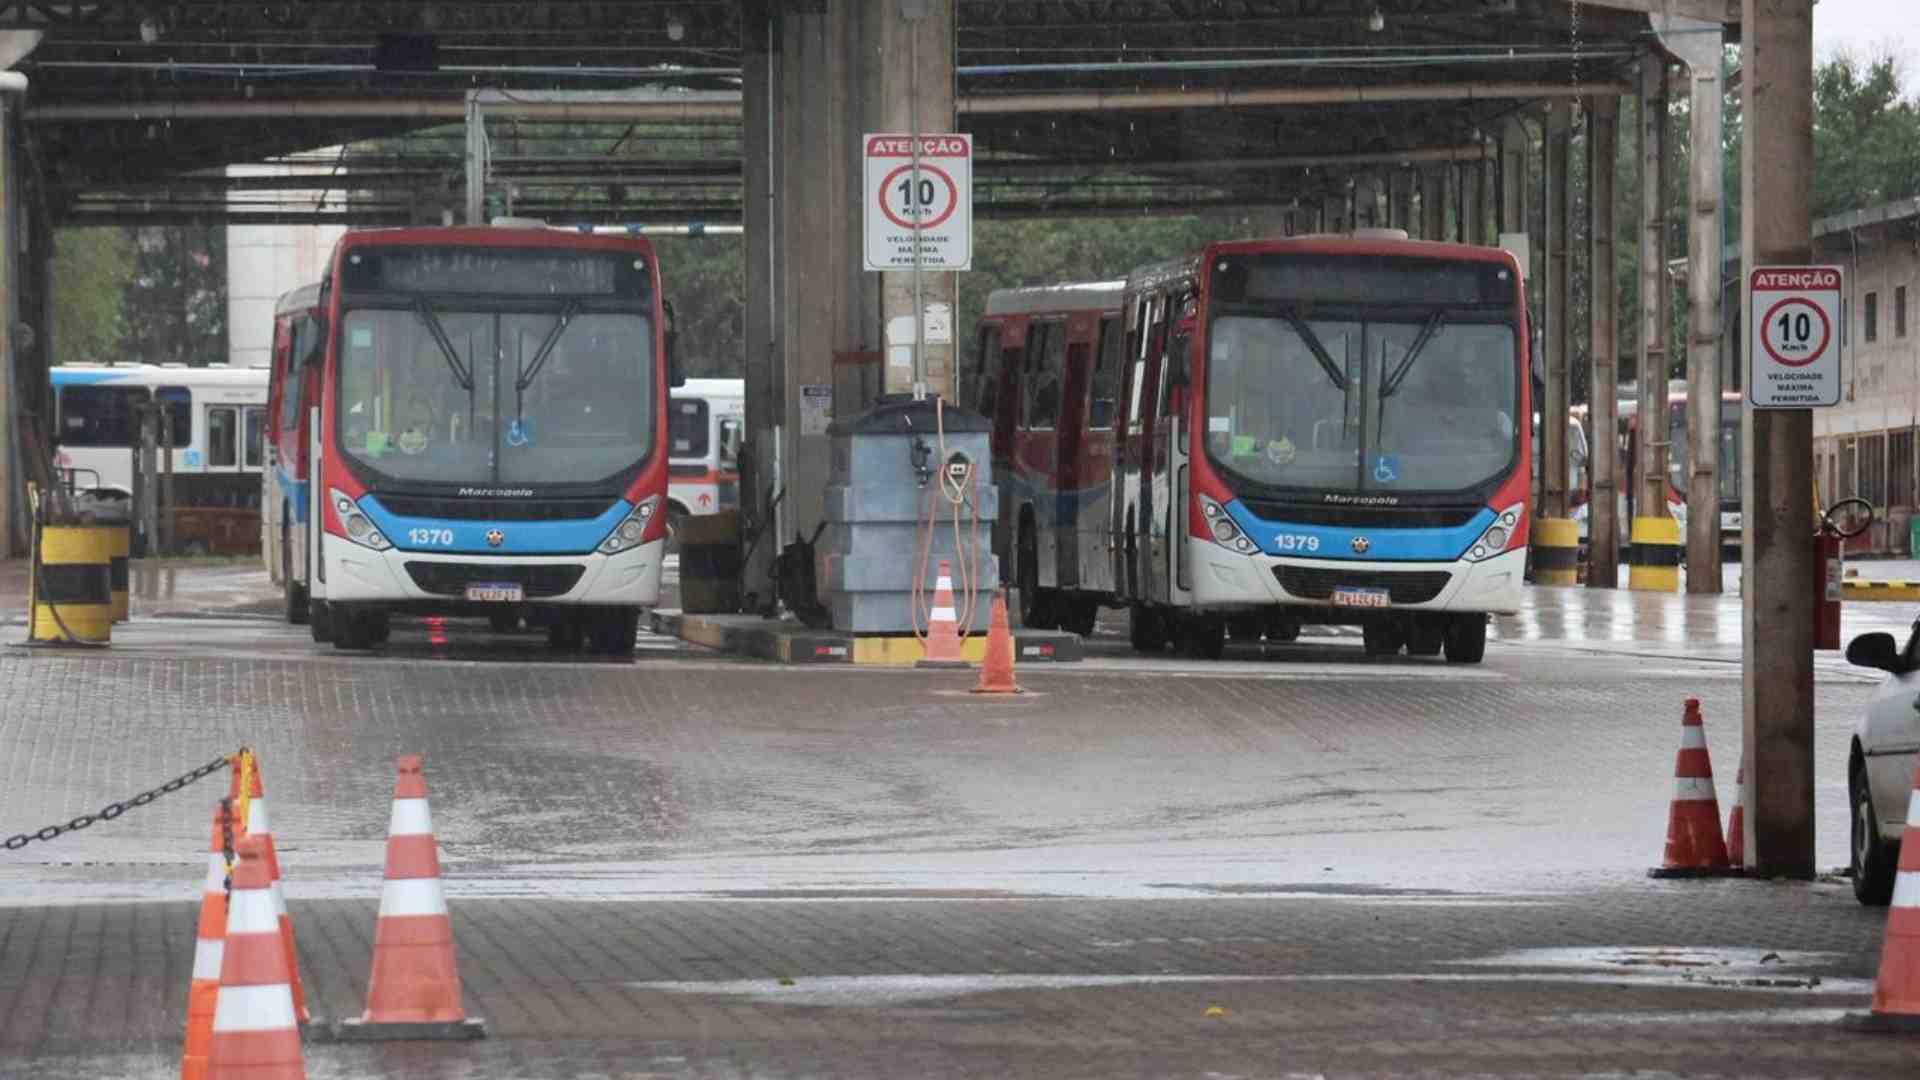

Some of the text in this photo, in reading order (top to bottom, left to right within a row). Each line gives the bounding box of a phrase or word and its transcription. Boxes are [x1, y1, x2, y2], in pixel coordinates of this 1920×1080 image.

[898, 178, 935, 206] 10
[902, 207, 932, 216] Kh
[1756, 272, 1836, 289] ATENÇÃO
[1778, 312, 1811, 342] 10
[1767, 372, 1825, 381] VELOCIDADE
[1770, 394, 1821, 402] PERMITIDA
[1323, 493, 1399, 505] Marcopolo
[408, 527, 454, 545] 1370
[1274, 533, 1320, 551] 1379
